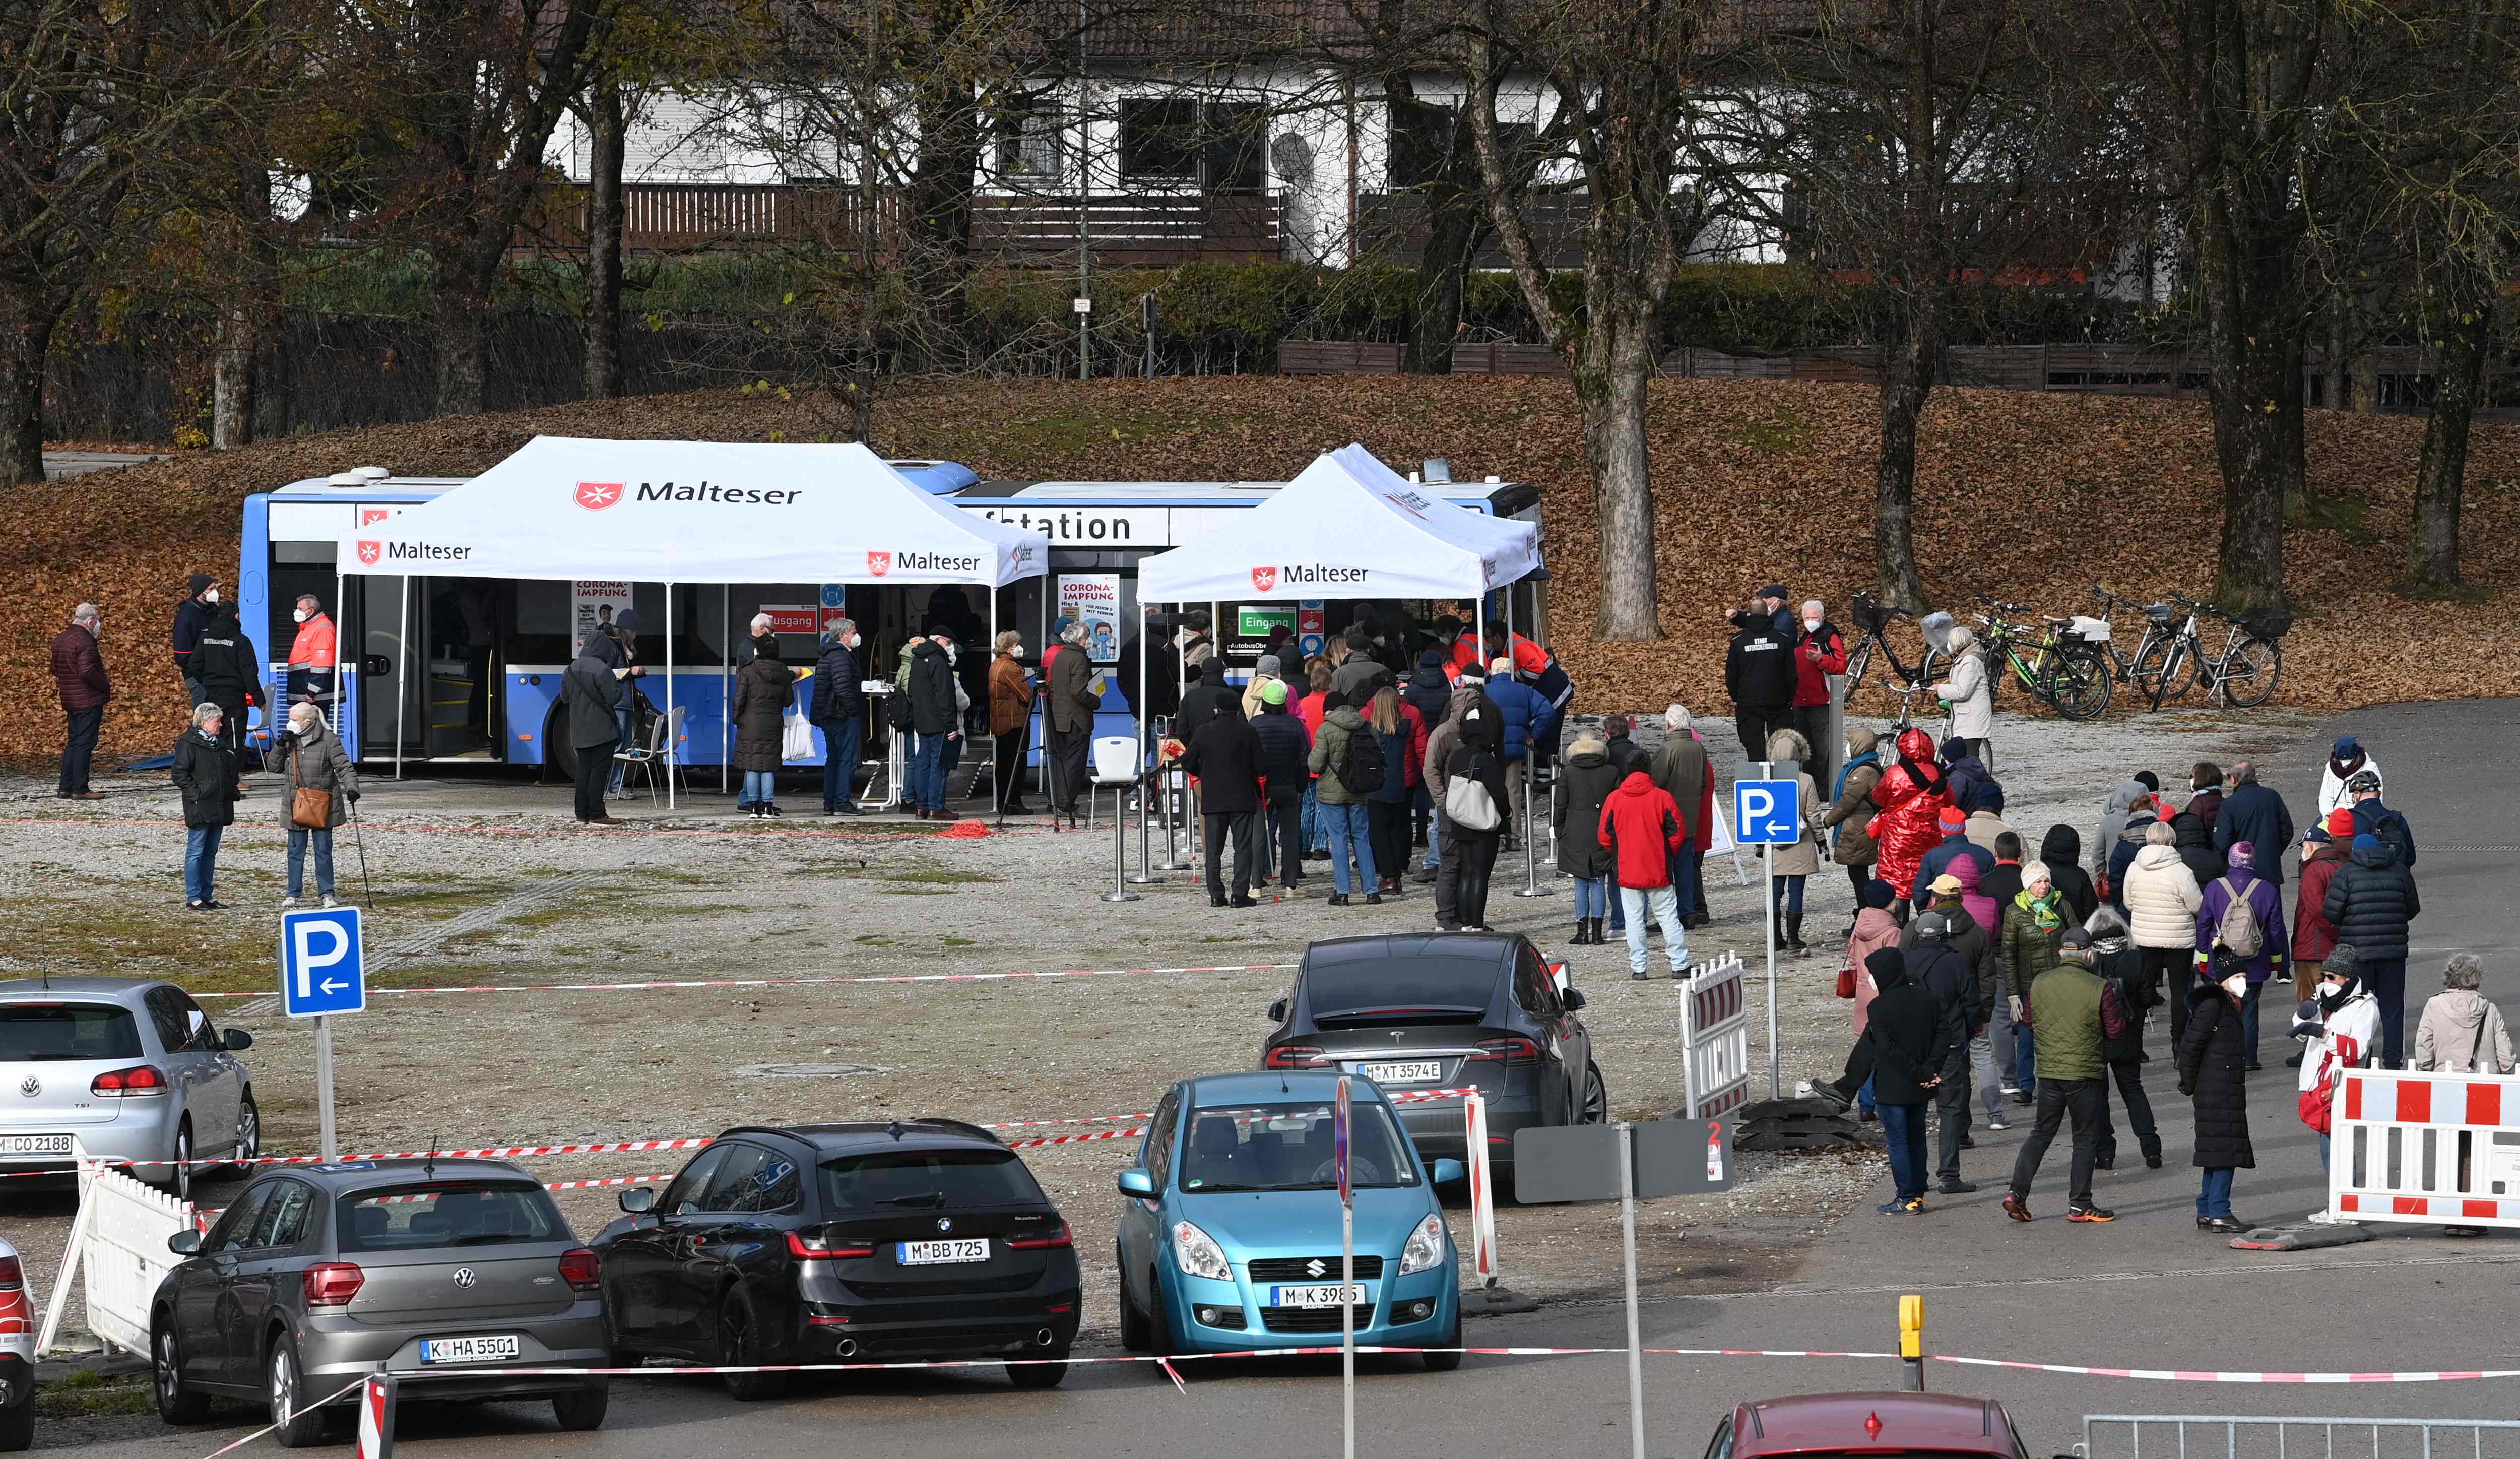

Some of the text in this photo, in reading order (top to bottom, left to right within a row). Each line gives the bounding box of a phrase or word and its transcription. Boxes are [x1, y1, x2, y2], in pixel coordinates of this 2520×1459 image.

[636, 481, 802, 504] Malteser
[986, 511, 1130, 539] tation
[389, 541, 472, 559] Malteser
[898, 552, 981, 570] Malteser
[1284, 563, 1369, 583] Malteser
[576, 580, 628, 588] CORONA-
[577, 589, 628, 597] IMPFUNG
[1064, 592, 1114, 600] IMPFUNG
[773, 617, 812, 628] usgang
[1246, 617, 1289, 629] Eingang
[1741, 789, 1774, 836] P
[294, 920, 349, 998] P
[1383, 1065, 1398, 1079] XT
[1400, 1064, 1429, 1078] 3574
[1432, 1063, 1439, 1077] E
[1708, 1121, 1721, 1145] 2
[15, 1138, 32, 1151] CO
[35, 1137, 69, 1151] 2188
[912, 1241, 983, 1259] M BB 725
[1286, 1289, 1296, 1303] M
[1306, 1288, 1315, 1303] K
[431, 1338, 515, 1357] K HA 5501
